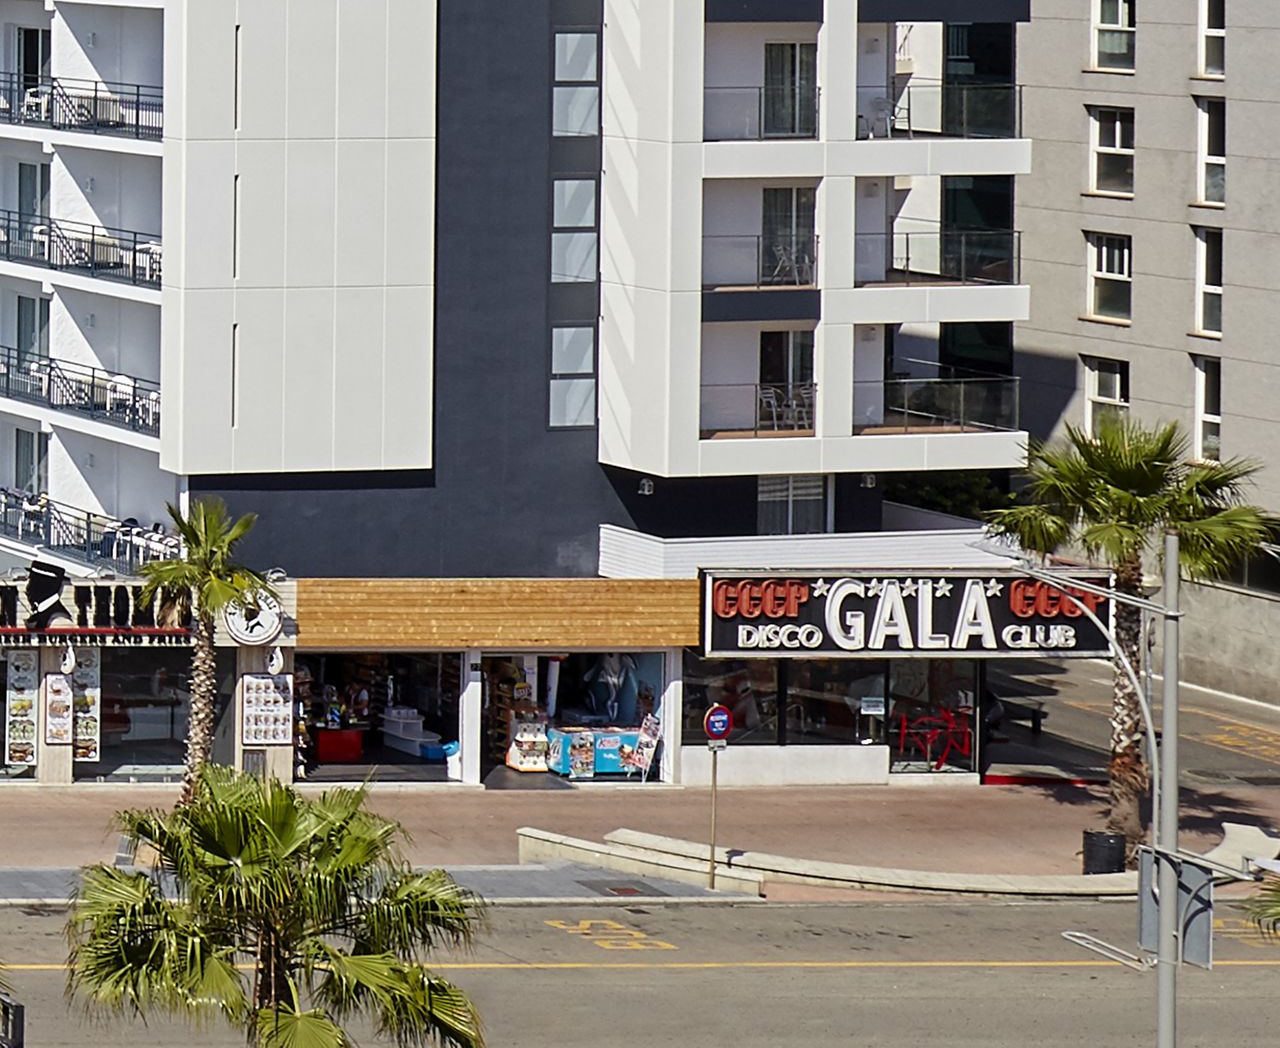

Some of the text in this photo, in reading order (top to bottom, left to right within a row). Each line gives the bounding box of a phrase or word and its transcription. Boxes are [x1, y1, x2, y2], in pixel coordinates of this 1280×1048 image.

[824, 577, 998, 650] GALA
[737, 624, 824, 648] DISCO
[1001, 624, 1077, 648] CLUB
